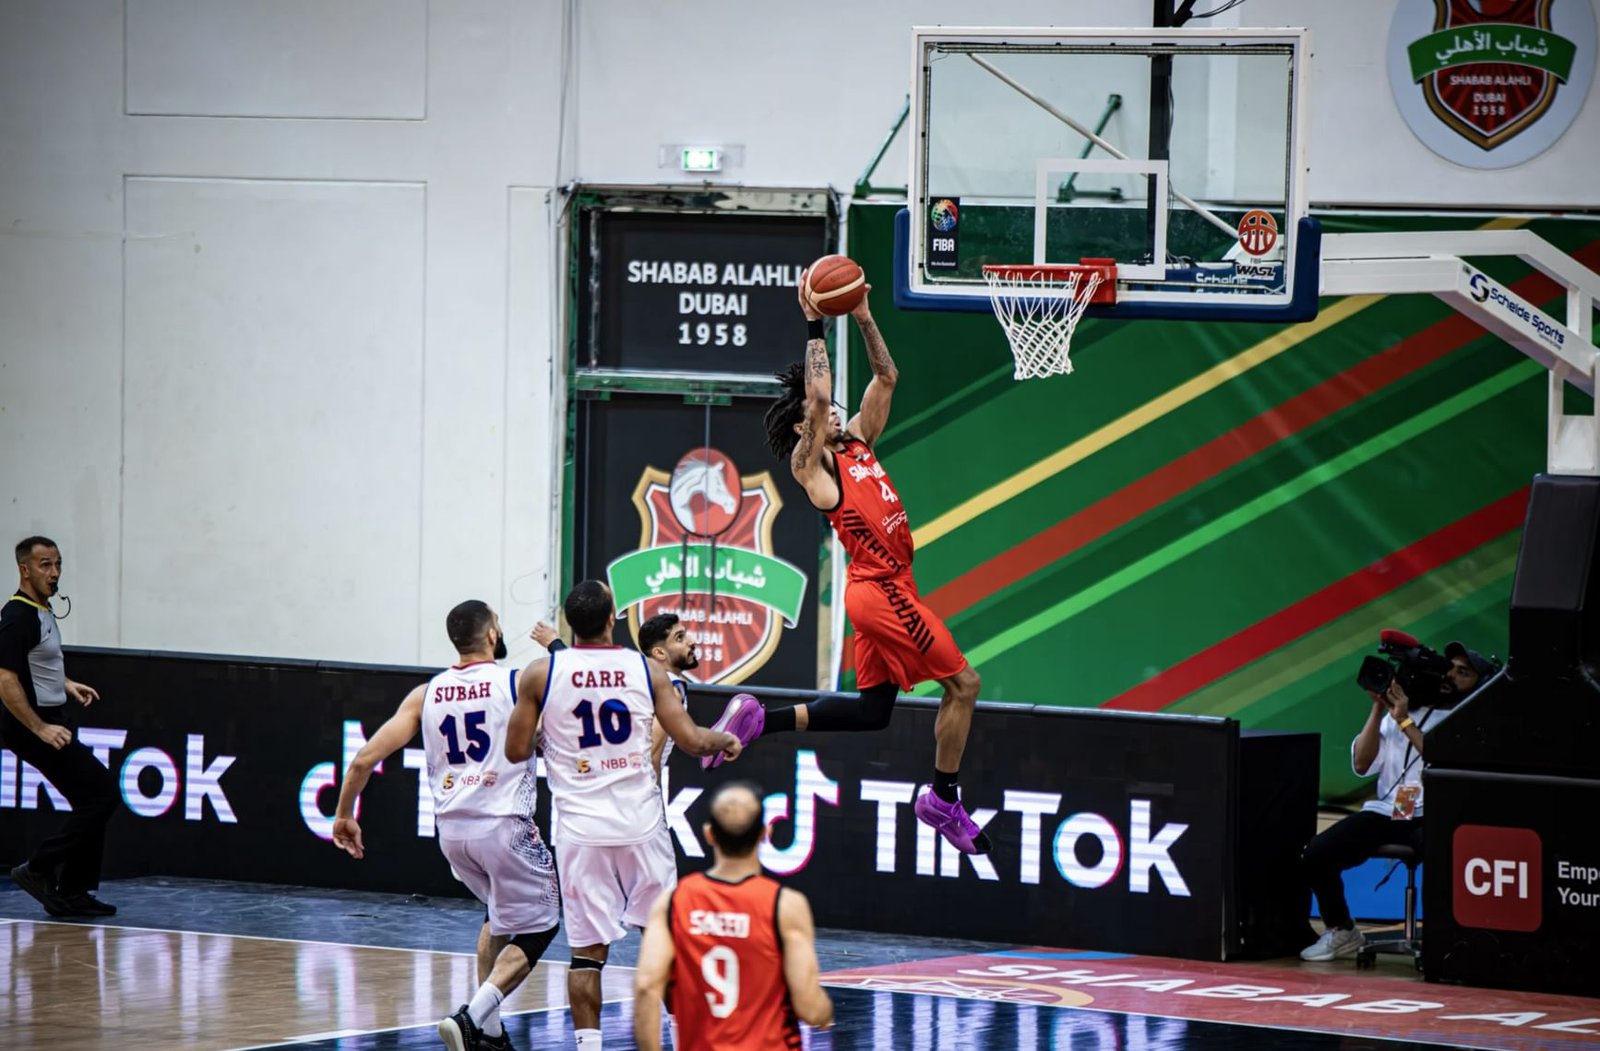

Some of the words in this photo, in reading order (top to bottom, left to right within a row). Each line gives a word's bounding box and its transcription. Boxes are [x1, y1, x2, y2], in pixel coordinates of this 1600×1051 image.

[1435, 30, 1492, 65] الأهلي
[1495, 33, 1549, 58] شباب
[1449, 75, 1492, 86] SHABAB
[1494, 75, 1532, 86] ALAHLI
[1473, 92, 1506, 103] DUBAI
[1473, 105, 1506, 116] 1958
[932, 238, 955, 252] FIBA
[627, 260, 718, 286] SHABAB
[721, 263, 802, 288] ALAHLI
[1235, 264, 1275, 278] WASL
[678, 292, 748, 316] DUBAI
[678, 321, 748, 347] 1958
[1531, 314, 1565, 345] Sports
[693, 647, 723, 662] 958
[571, 670, 628, 689] CARR
[433, 681, 492, 704] SUBAH
[572, 698, 633, 750] 10
[438, 709, 492, 766] 15
[600, 757, 628, 770] NBB
[860, 779, 1192, 897] TikTok
[1463, 857, 1529, 900] CFI
[1557, 860, 1600, 885] Emp
[1557, 886, 1600, 907] Your
[701, 944, 740, 1019] 9
[956, 963, 1446, 1014] SHABAB
[1435, 1010, 1600, 1036] AL
